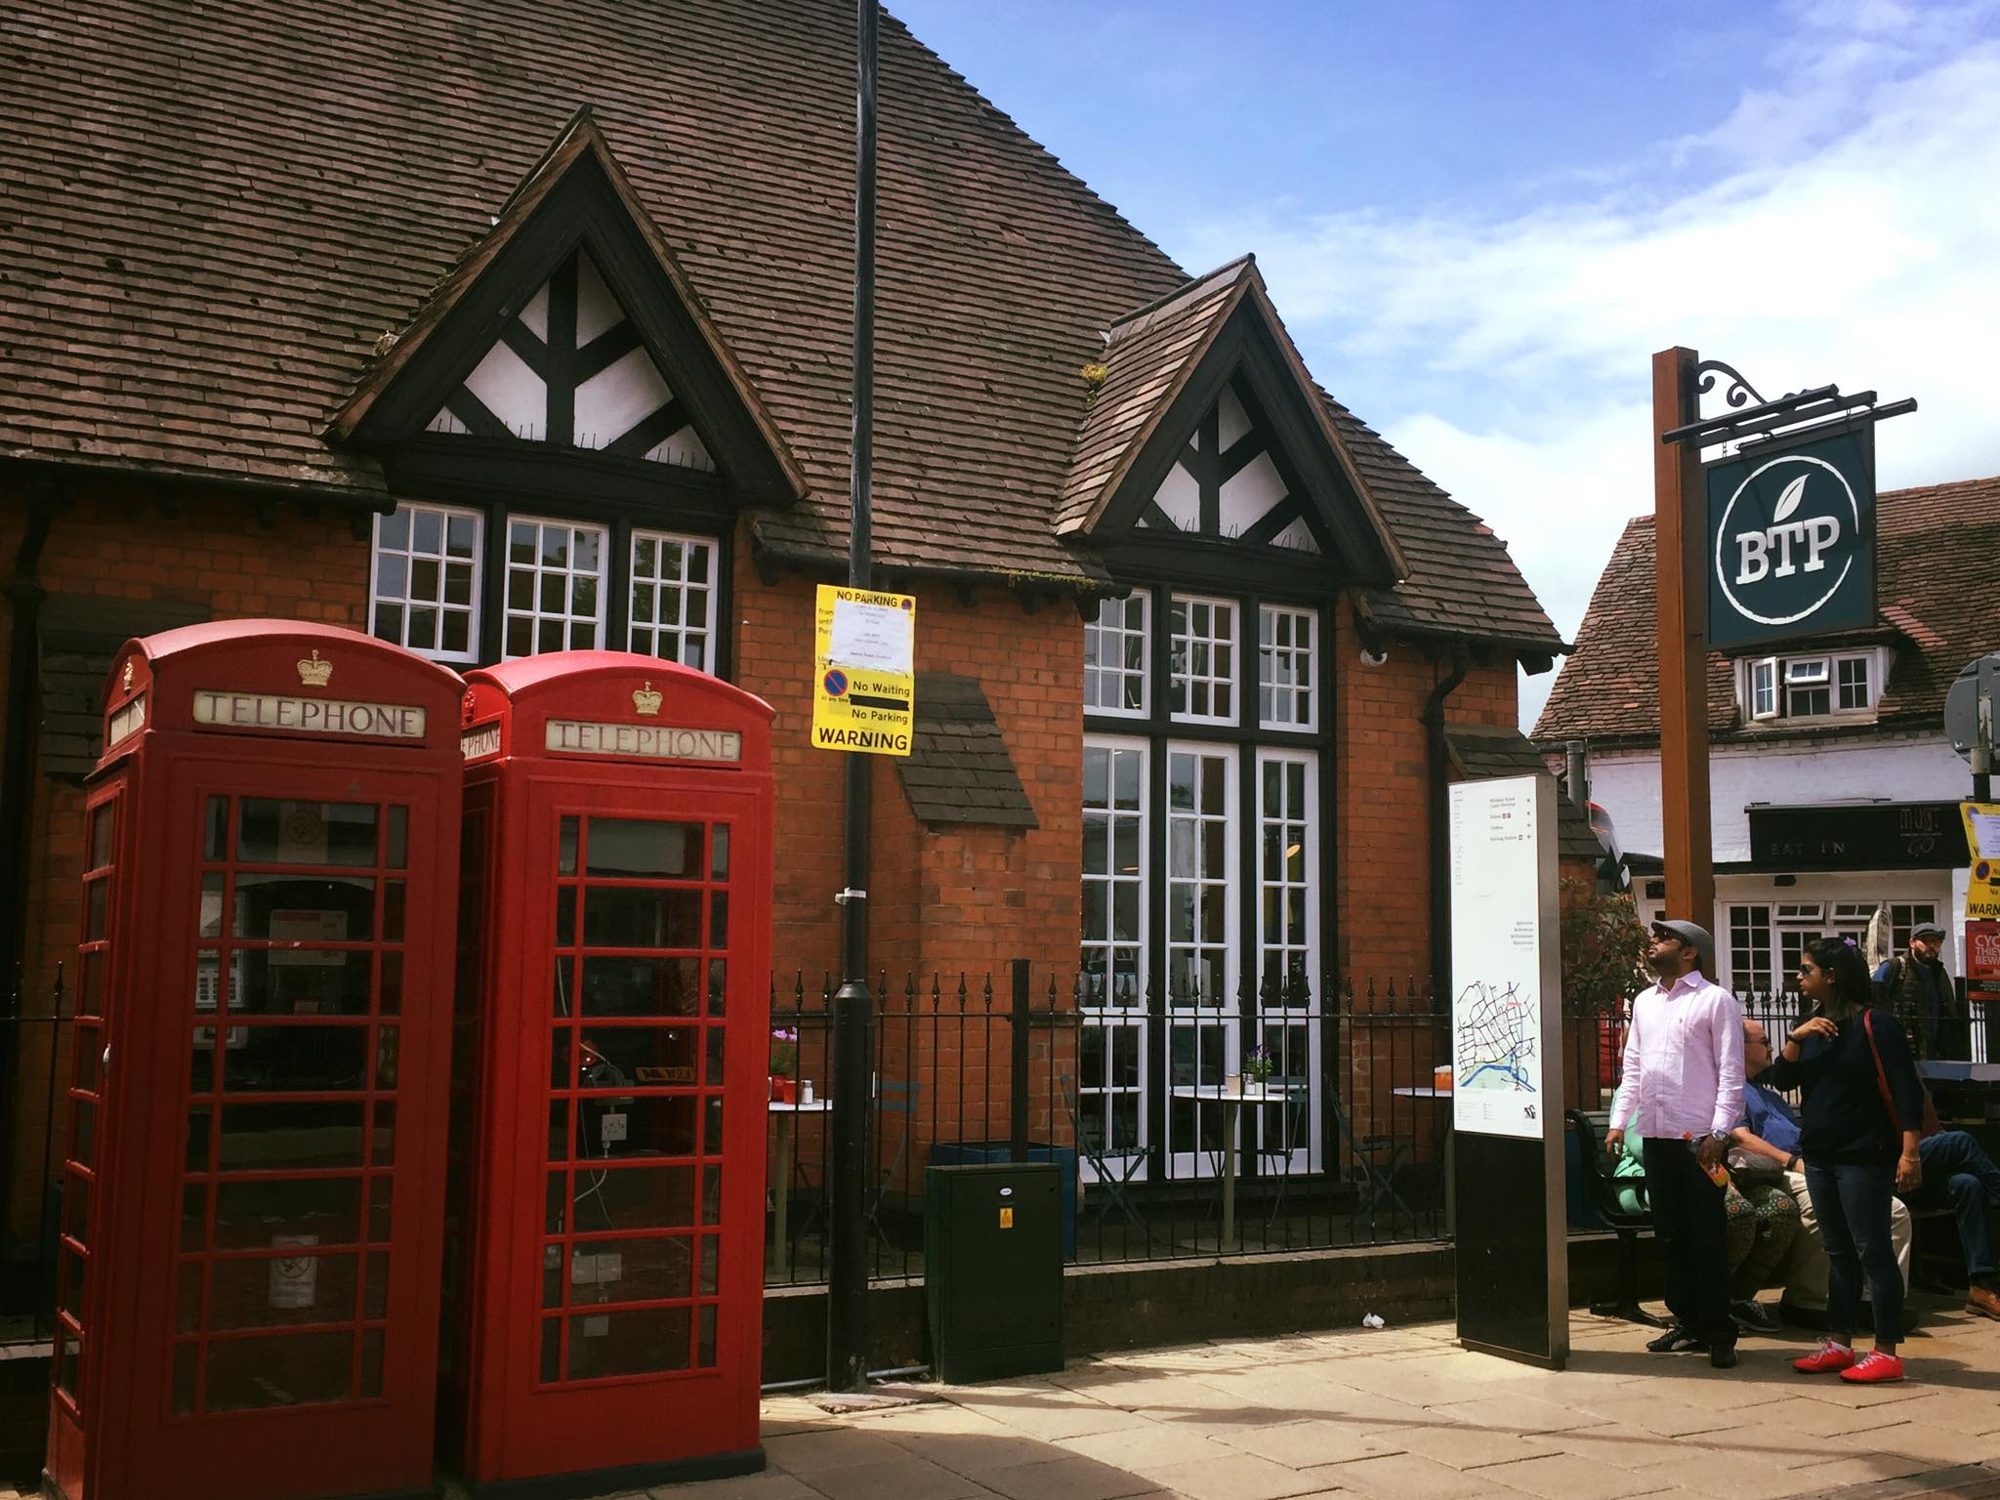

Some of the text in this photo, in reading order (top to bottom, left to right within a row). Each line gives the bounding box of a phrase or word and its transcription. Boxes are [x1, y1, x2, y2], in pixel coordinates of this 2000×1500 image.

[1735, 515, 1841, 586] BTP
[836, 590, 898, 608] NO PARKING
[853, 681, 910, 698] No Waiting
[204, 693, 418, 736] TELEPHONE
[852, 709, 908, 726] No Parking
[555, 721, 734, 760] TELEPHONE
[819, 728, 907, 751] WARNING
[1771, 841, 1845, 856] EAT IN
